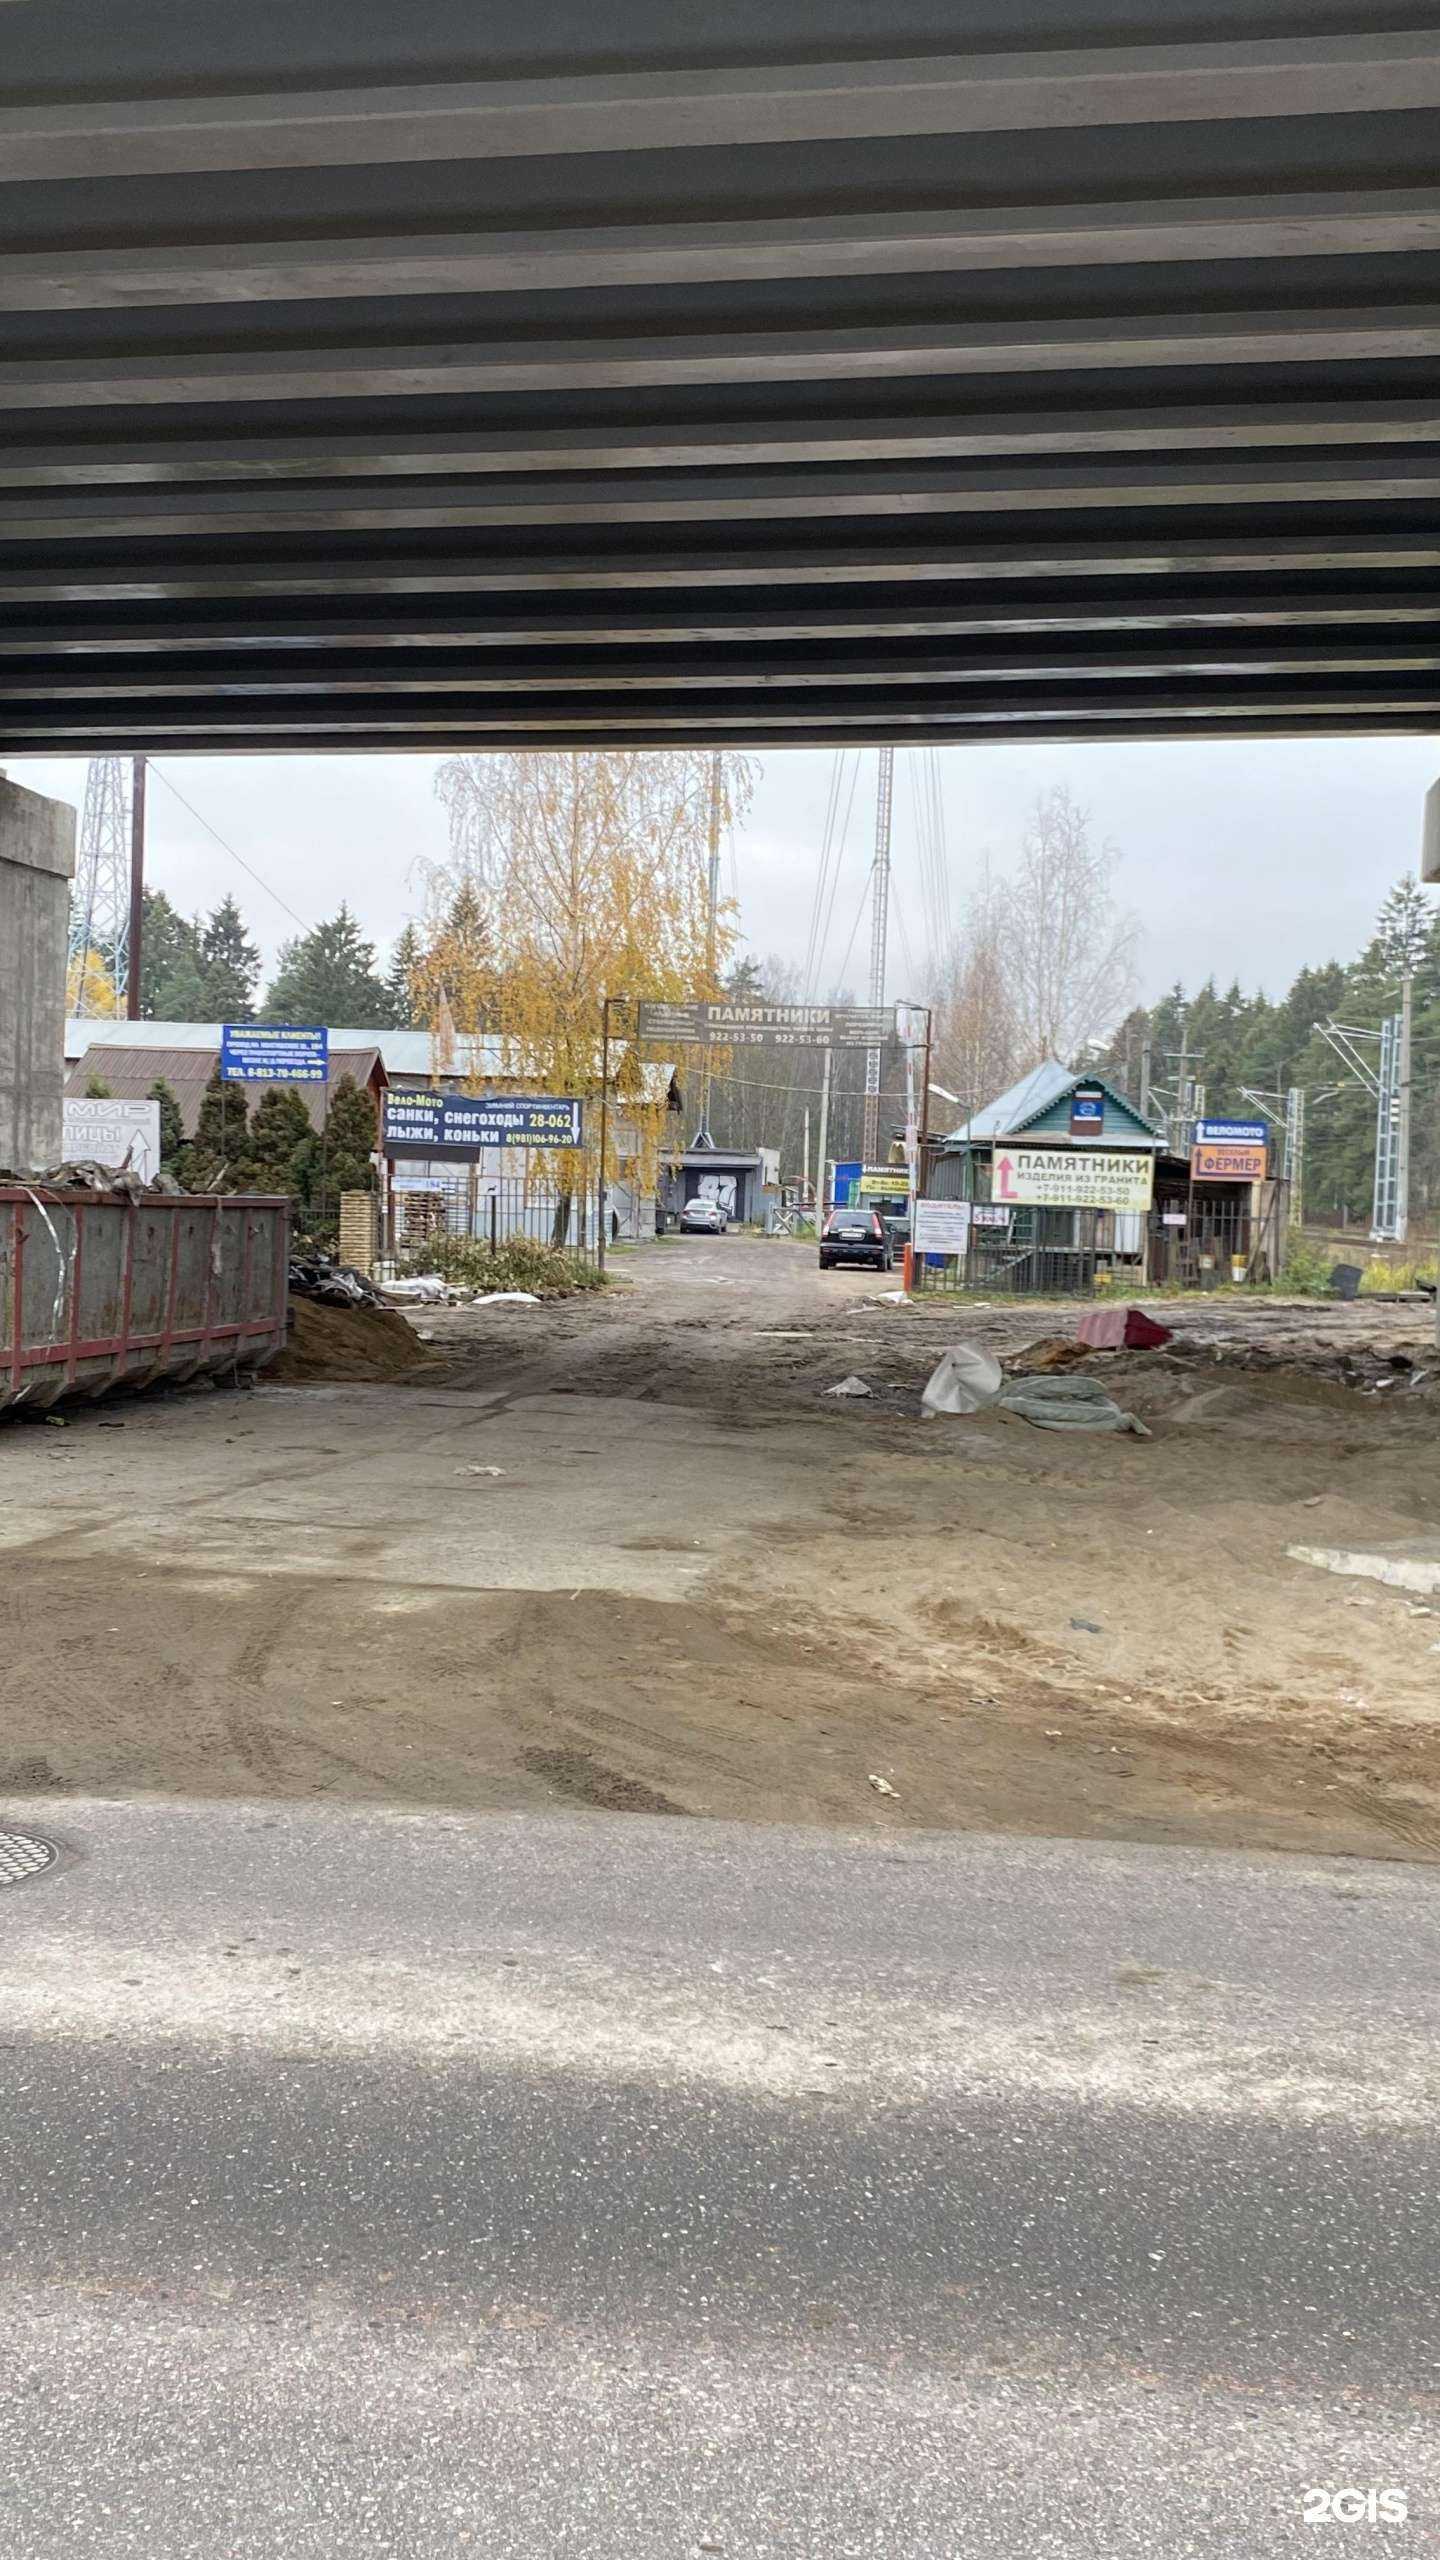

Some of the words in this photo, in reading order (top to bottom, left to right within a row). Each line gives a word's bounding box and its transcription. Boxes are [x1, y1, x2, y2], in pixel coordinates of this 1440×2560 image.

[707, 1005, 831, 1024] ПАМЯТНИКИ
[709, 1031, 764, 1043] 922-53-50
[775, 1033, 830, 1045] 922-53-60
[529, 1113, 572, 1128] 28-062
[1017, 1154, 1150, 1175] ПАМЯТНИКИ
[1204, 1157, 1262, 1171] ФЕРМЕР
[1016, 1171, 1073, 1183] ИЗДЕЛИЯ
[1075, 1174, 1091, 1184] ИЗ
[1093, 1174, 1149, 1186] ГРАНИТА
[1036, 1183, 1131, 1196] +7-911-922-53-50
[1036, 1193, 1130, 1206] +7-911-922-53-60
